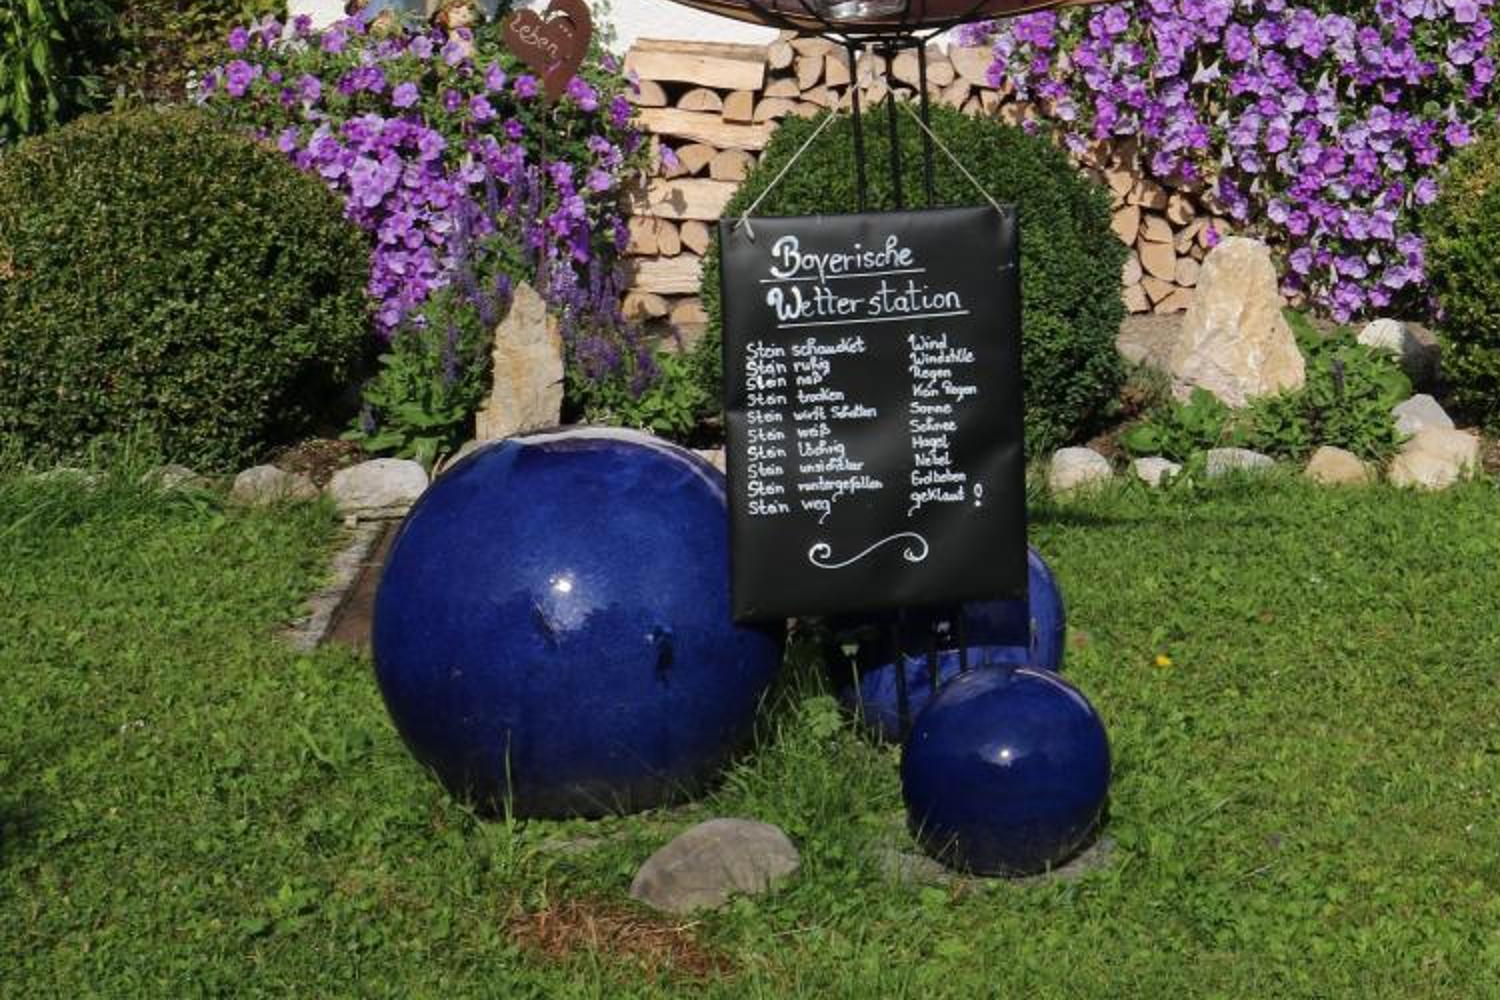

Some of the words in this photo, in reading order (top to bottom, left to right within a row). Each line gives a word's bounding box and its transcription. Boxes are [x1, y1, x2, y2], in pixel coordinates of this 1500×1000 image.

[765, 279, 962, 321] Wetterstation
[908, 333, 948, 351] Wind
[794, 356, 830, 376] ruhig
[908, 364, 953, 388] Regen
[909, 401, 953, 415] Sonne
[909, 415, 958, 433] Schnee
[912, 433, 951, 455] Hagel
[800, 499, 831, 525] weg
